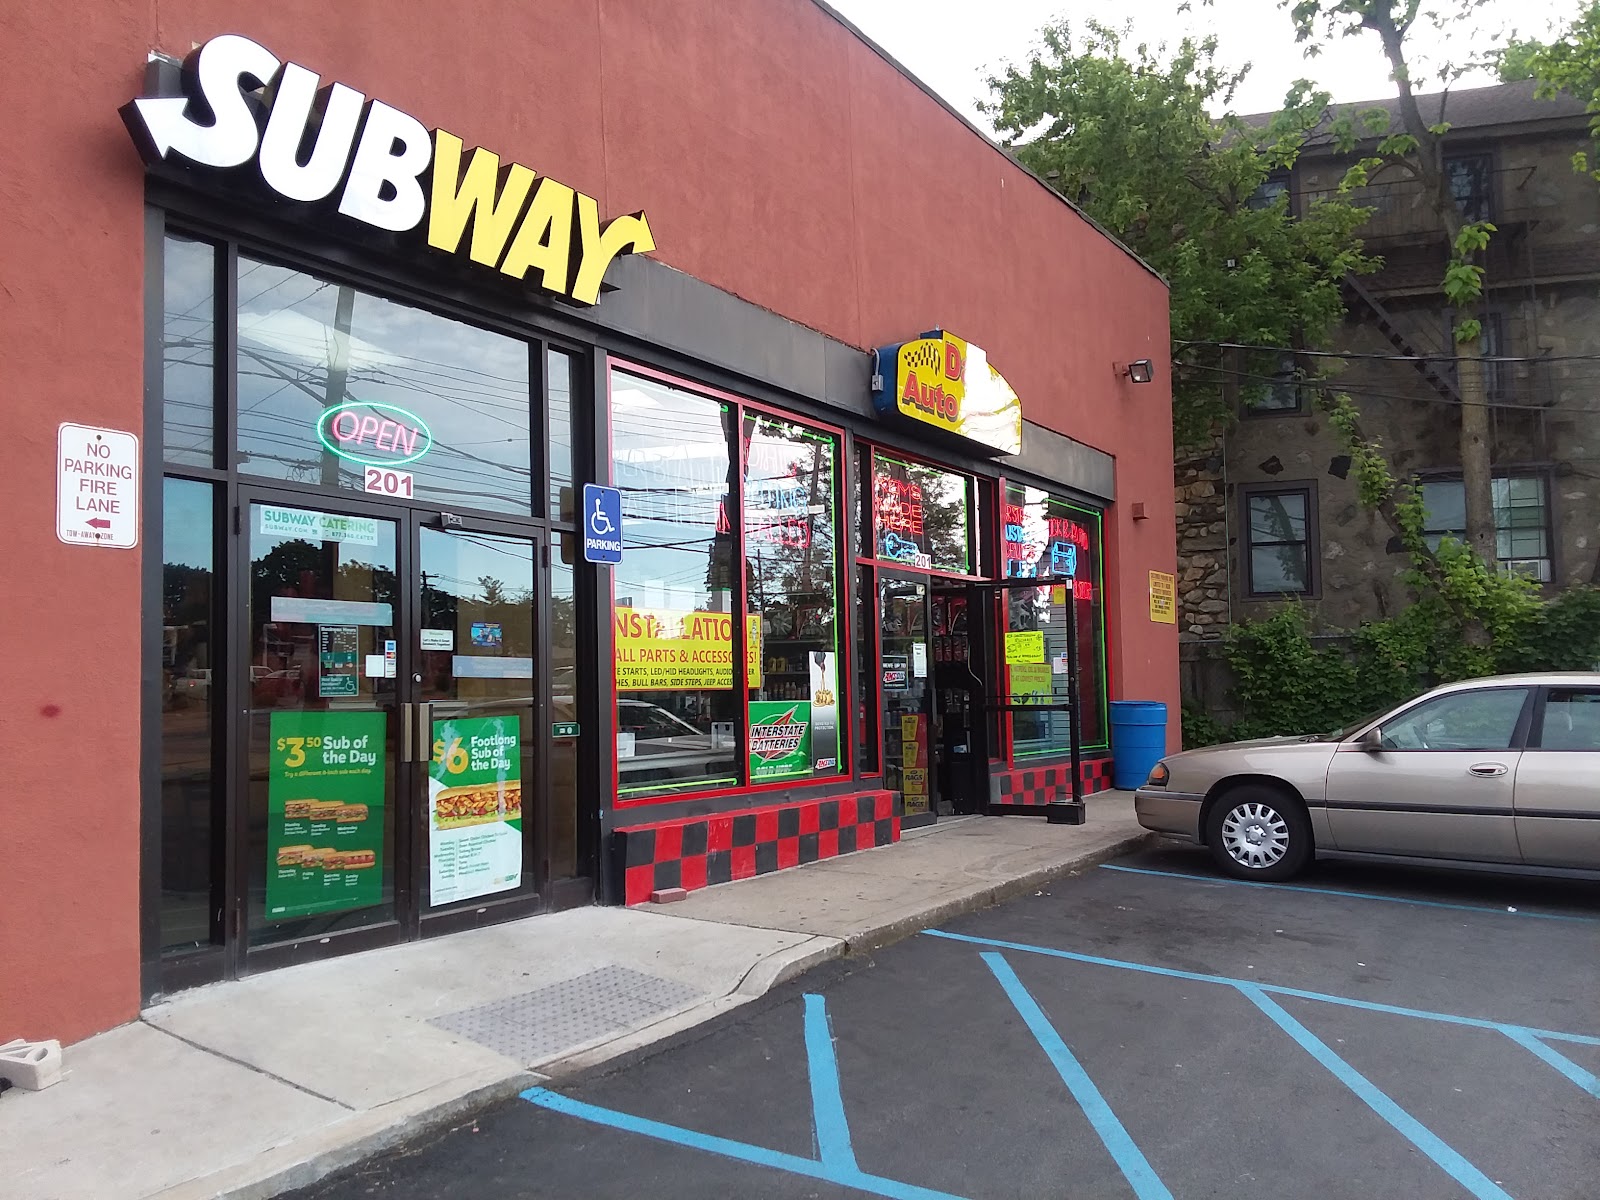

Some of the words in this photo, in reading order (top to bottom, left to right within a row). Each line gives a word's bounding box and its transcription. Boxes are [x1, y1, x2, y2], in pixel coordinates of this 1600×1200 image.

[132, 33, 657, 307] SUBWAY
[902, 370, 959, 423] Auto
[331, 410, 419, 456] OPEN
[86, 442, 111, 459] NO
[64, 458, 133, 480] PARKING
[79, 478, 118, 497] FIRE
[366, 469, 413, 497] 201
[75, 496, 121, 515] LANE
[264, 510, 316, 526] SUBWAY
[319, 517, 375, 533] CATERING
[66, 529, 96, 540] TOW-AWAY
[100, 532, 114, 541] ZONE
[586, 538, 621, 552] PARKING
[915, 554, 931, 568] 201
[616, 648, 636, 662] ALL
[639, 648, 676, 663] PARTS
[679, 649, 689, 663] &
[622, 667, 649, 677] STARTS,
[650, 667, 677, 677] LED/HID
[678, 668, 715, 677] HEADLIGHTS,
[632, 678, 649, 687] BULL
[650, 678, 669, 687] BARS,
[669, 678, 684, 686] SIDE
[684, 678, 703, 687] STEPS,
[703, 678, 717, 686] JEEP
[751, 725, 805, 738] INTERSTATE
[323, 735, 351, 750] Sub
[353, 734, 369, 749] of
[470, 734, 517, 748] Footlong
[751, 738, 799, 751] BATTERIES
[322, 750, 347, 765] the
[349, 750, 377, 766] Day
[471, 747, 492, 760] Sub
[492, 745, 505, 757] of
[470, 760, 489, 771] the
[490, 758, 511, 771] Day
